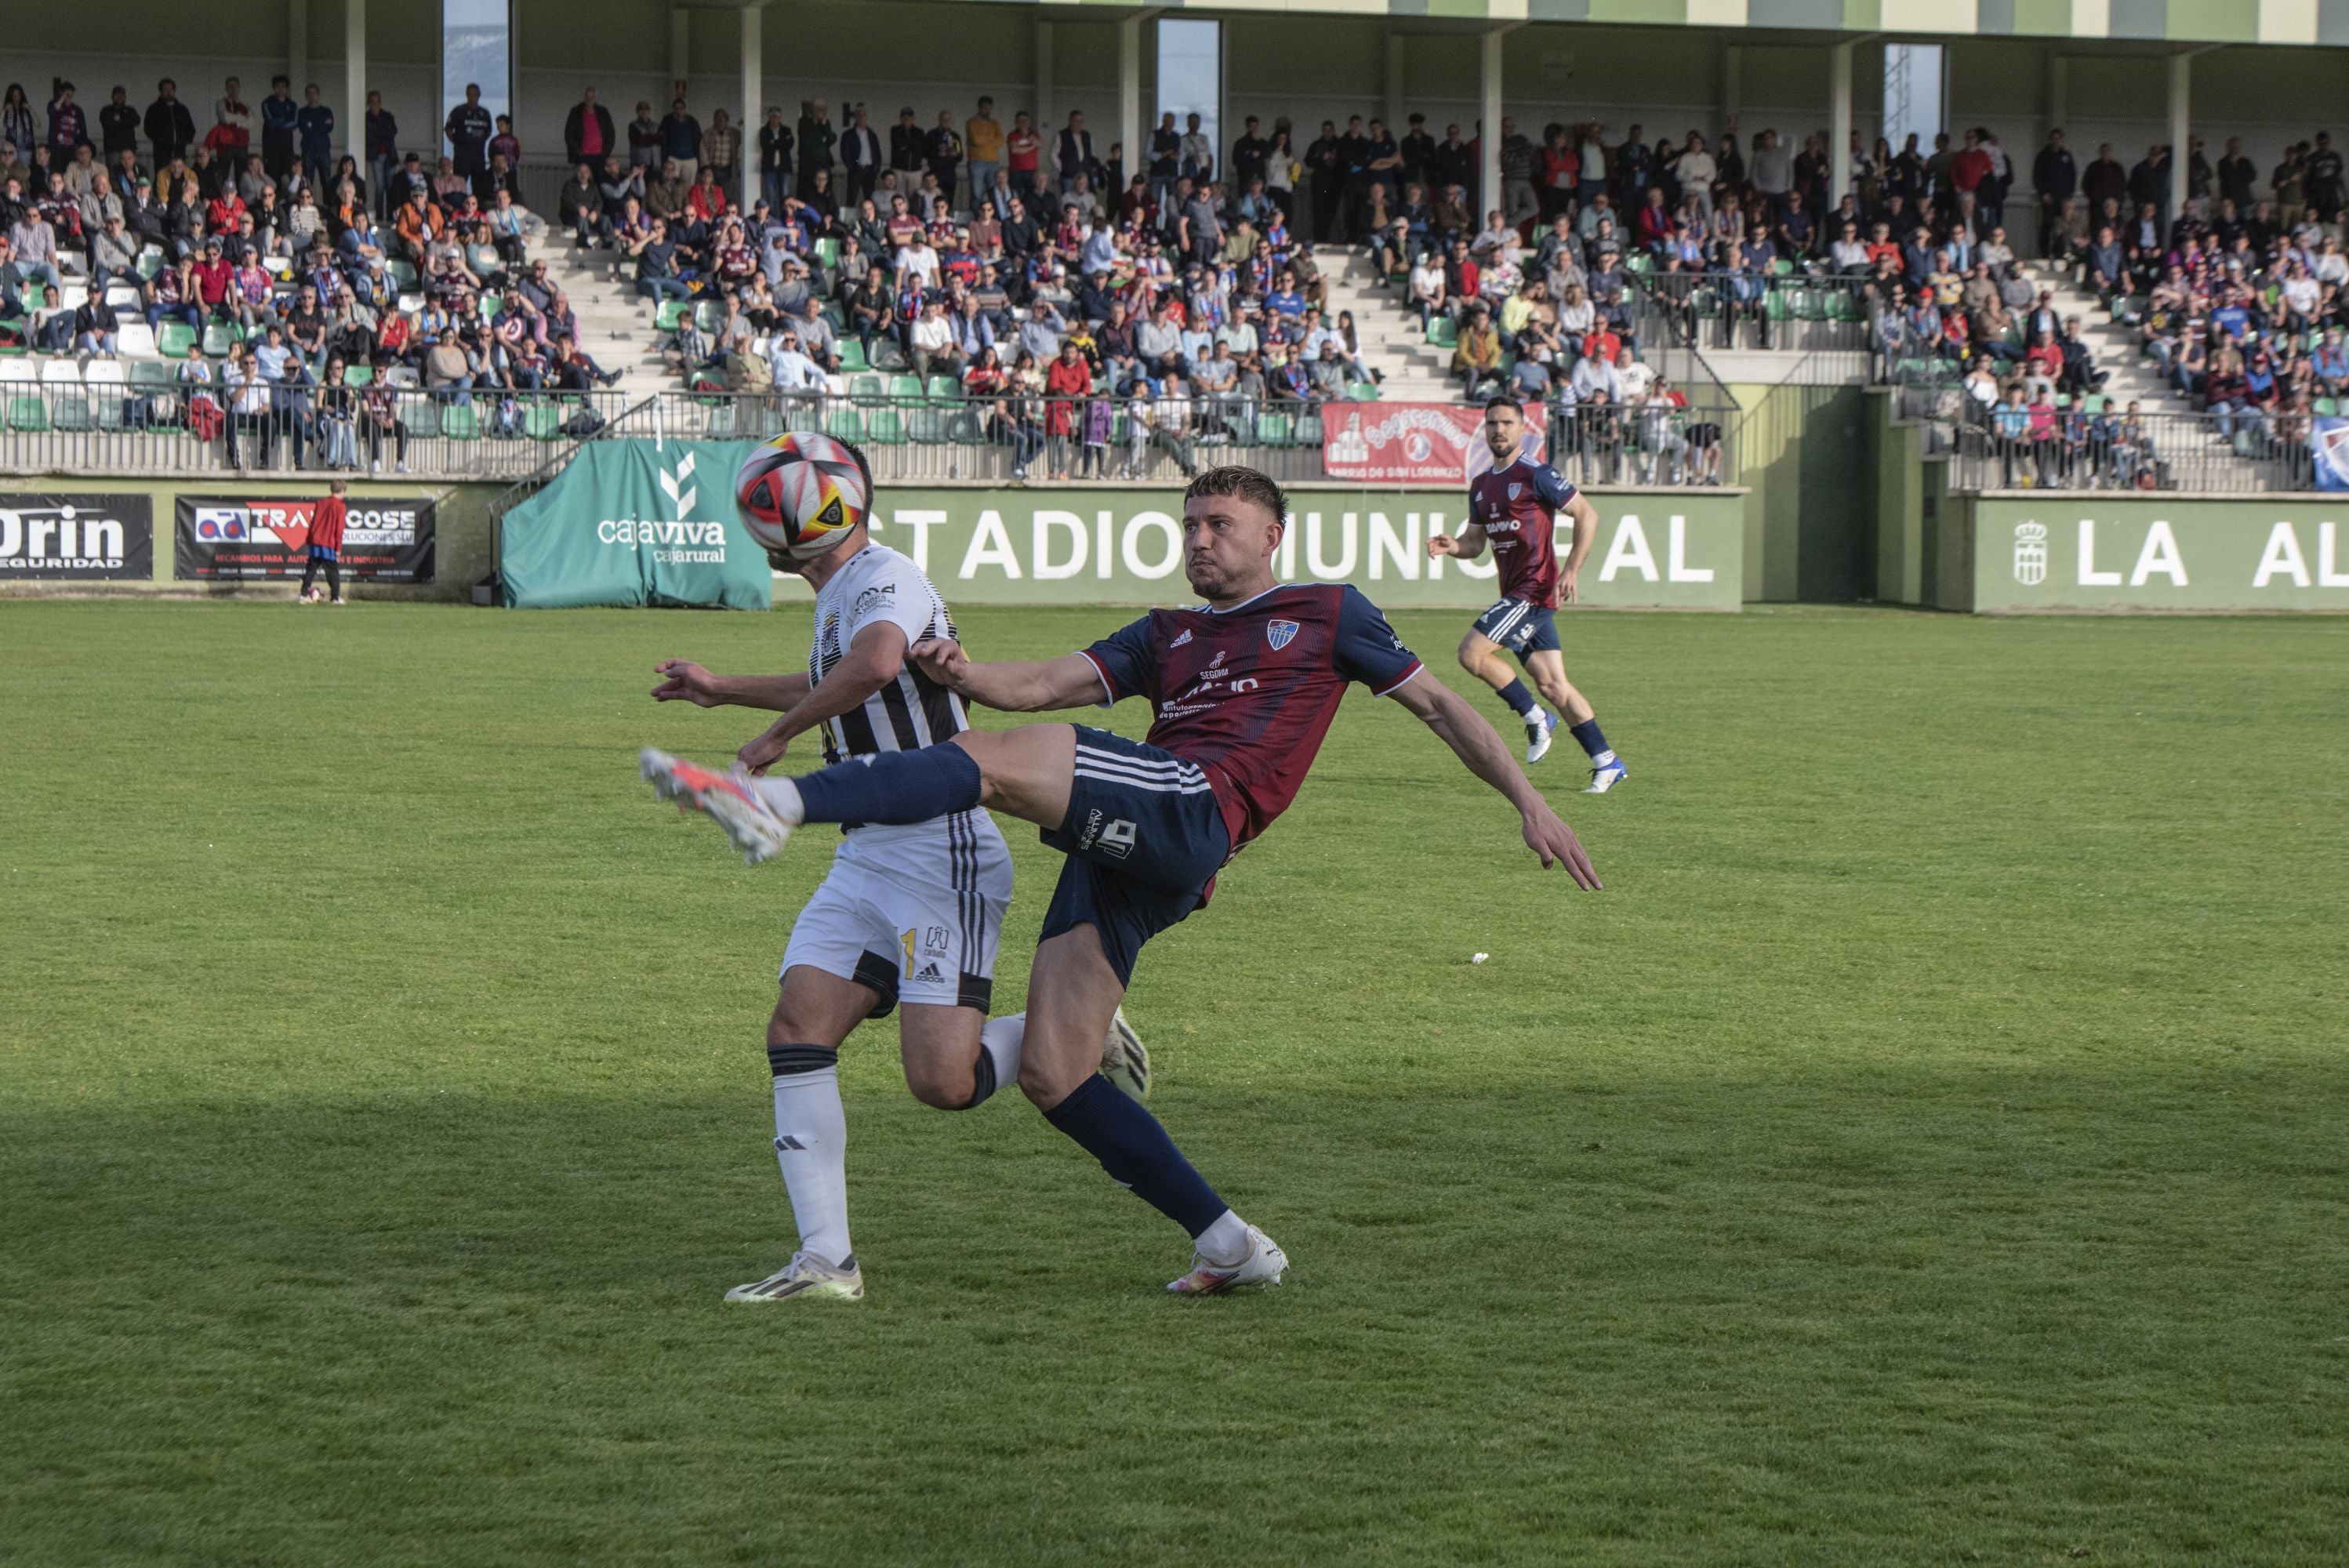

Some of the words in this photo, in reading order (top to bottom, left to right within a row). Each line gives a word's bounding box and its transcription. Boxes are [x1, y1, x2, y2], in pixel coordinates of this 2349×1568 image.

[597, 512, 726, 550] cajaviva
[772, 510, 1182, 579] TADIO
[2078, 520, 2189, 586] LA
[2252, 521, 2349, 587] AL
[263, 554, 283, 563] PARA
[653, 546, 726, 565] cajarural
[1200, 668, 1229, 681] SEGOVIA
[915, 975, 946, 984] adidas
